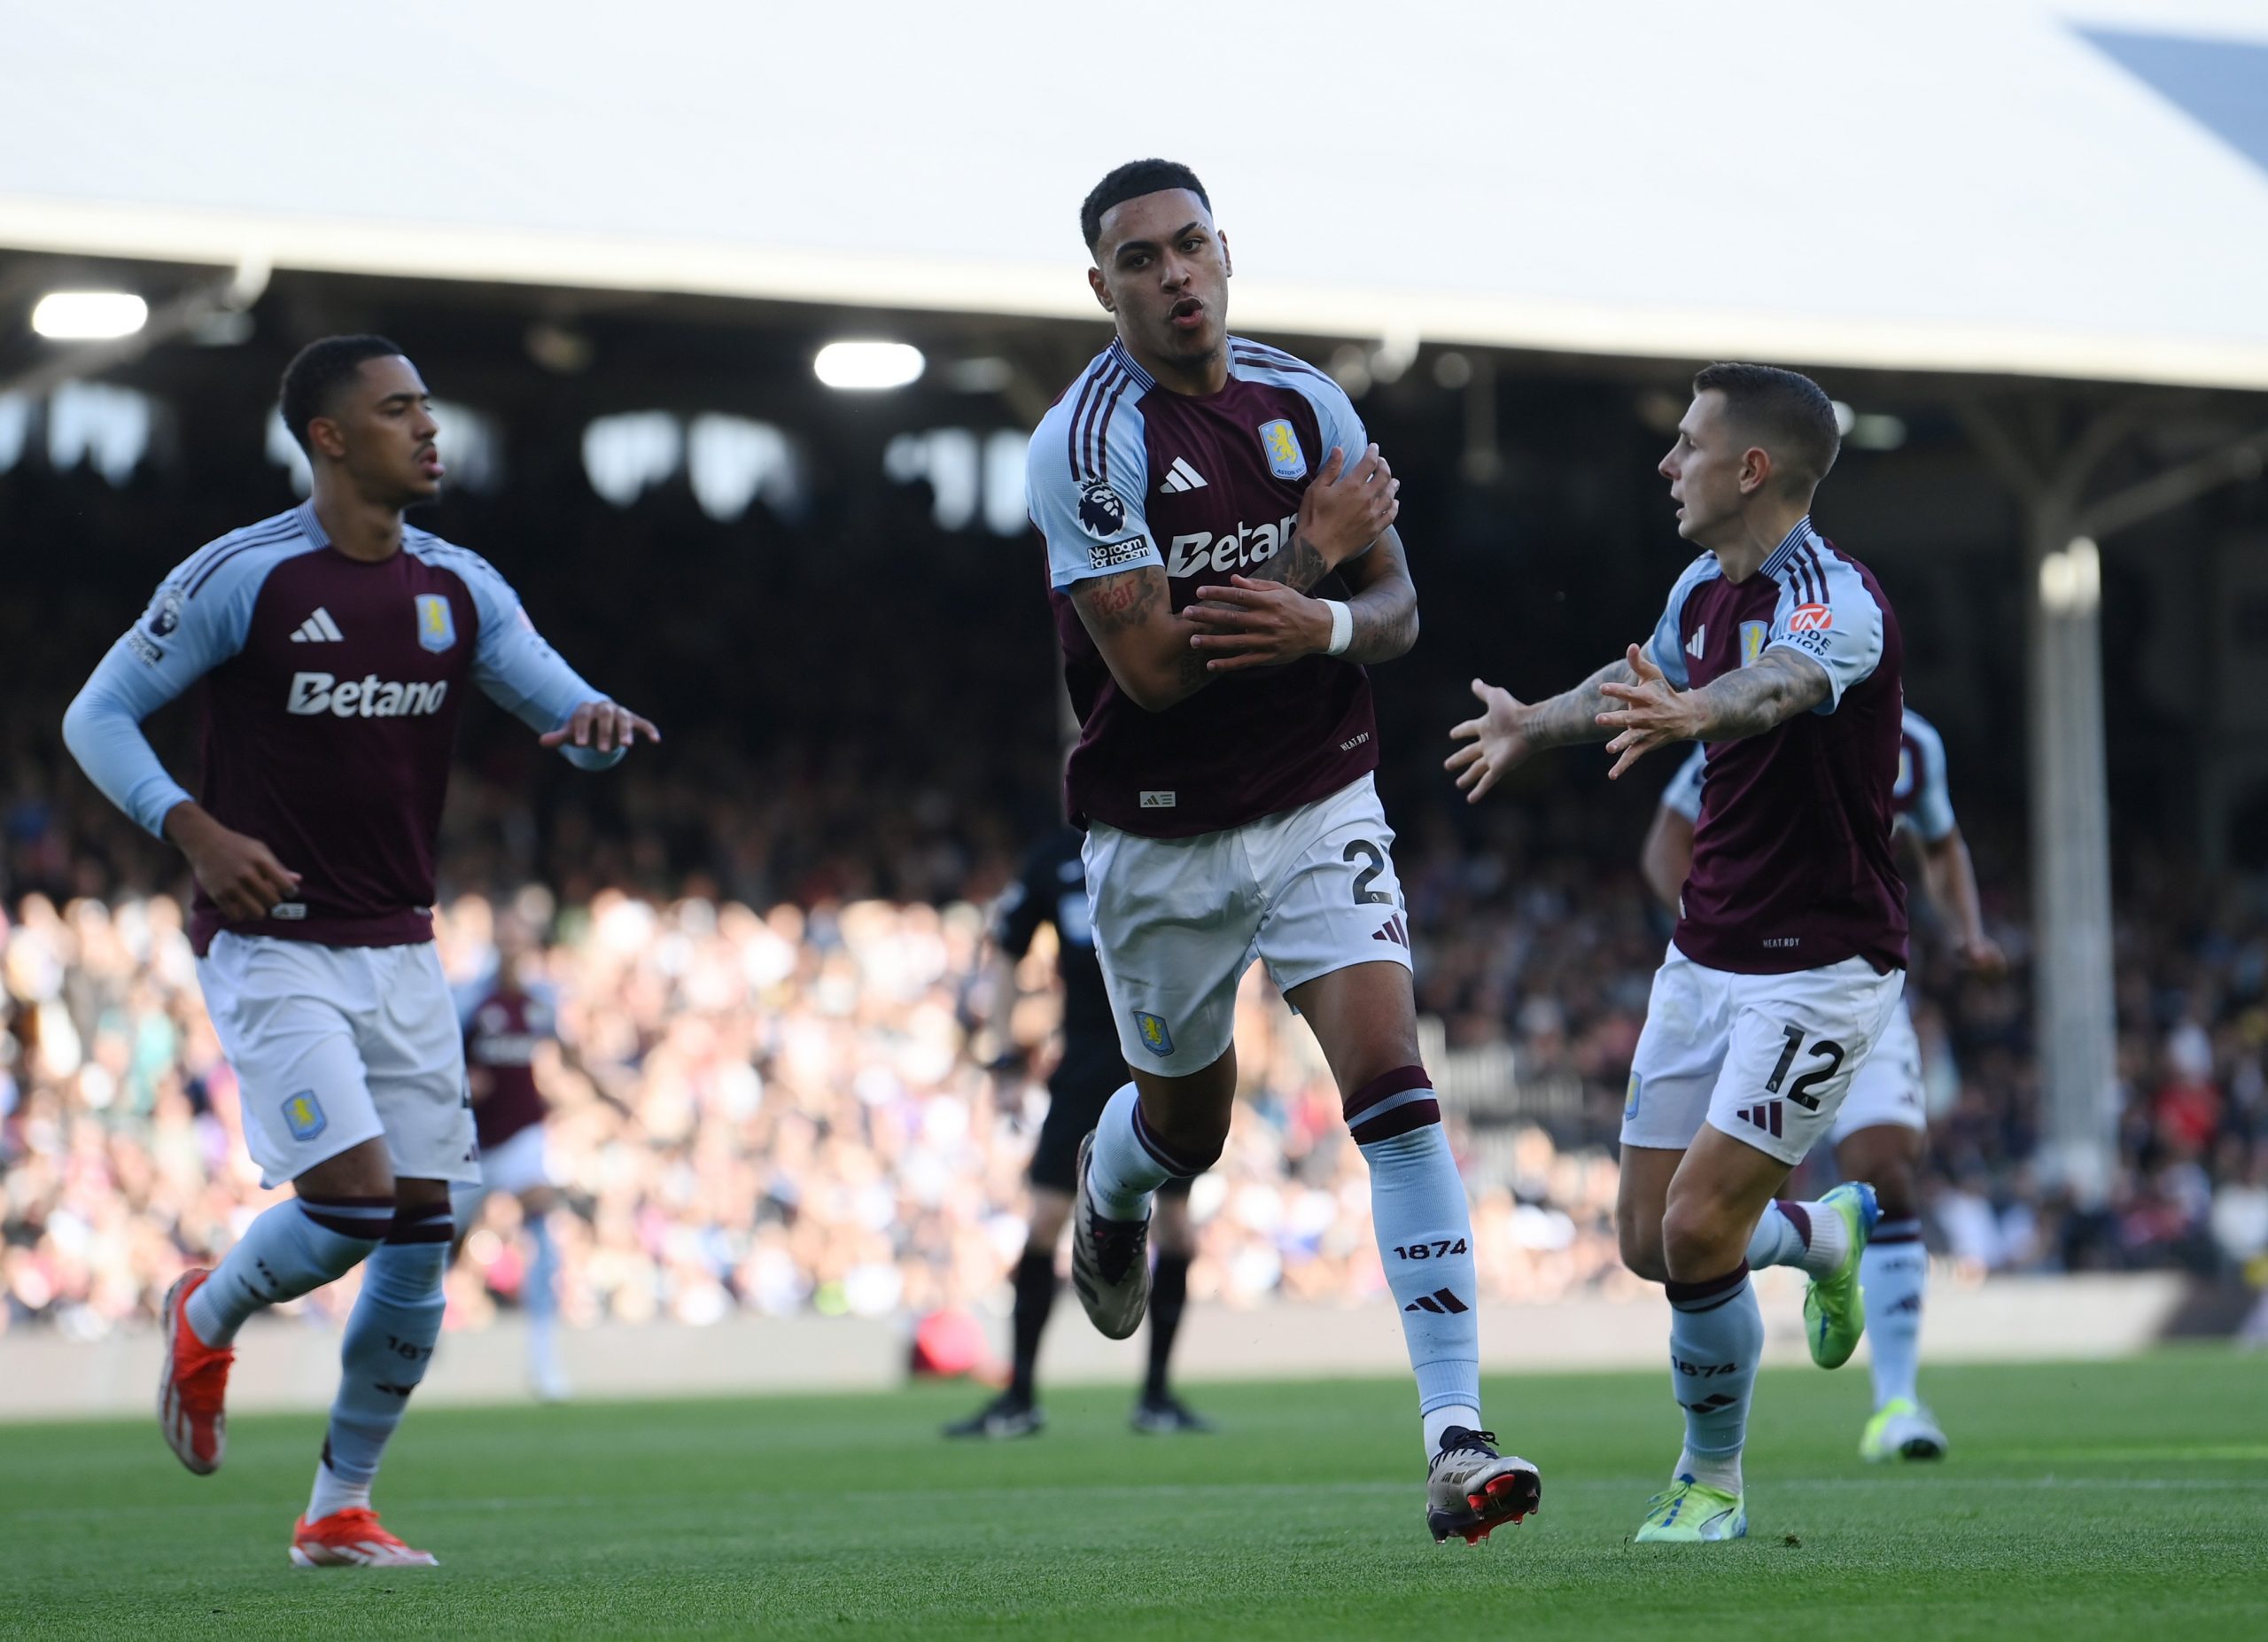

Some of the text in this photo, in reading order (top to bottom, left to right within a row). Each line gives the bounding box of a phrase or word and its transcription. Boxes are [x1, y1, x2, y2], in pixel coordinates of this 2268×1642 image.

[1088, 538, 1143, 560] No room
[1090, 546, 1150, 570] for racism
[1166, 514, 1299, 578] Betan
[287, 672, 448, 719] Betano
[1342, 838, 1395, 906] 2
[1765, 1024, 1845, 1112] 12
[1393, 1237, 1468, 1260] 1874
[1672, 1355, 1738, 1379] 1874
